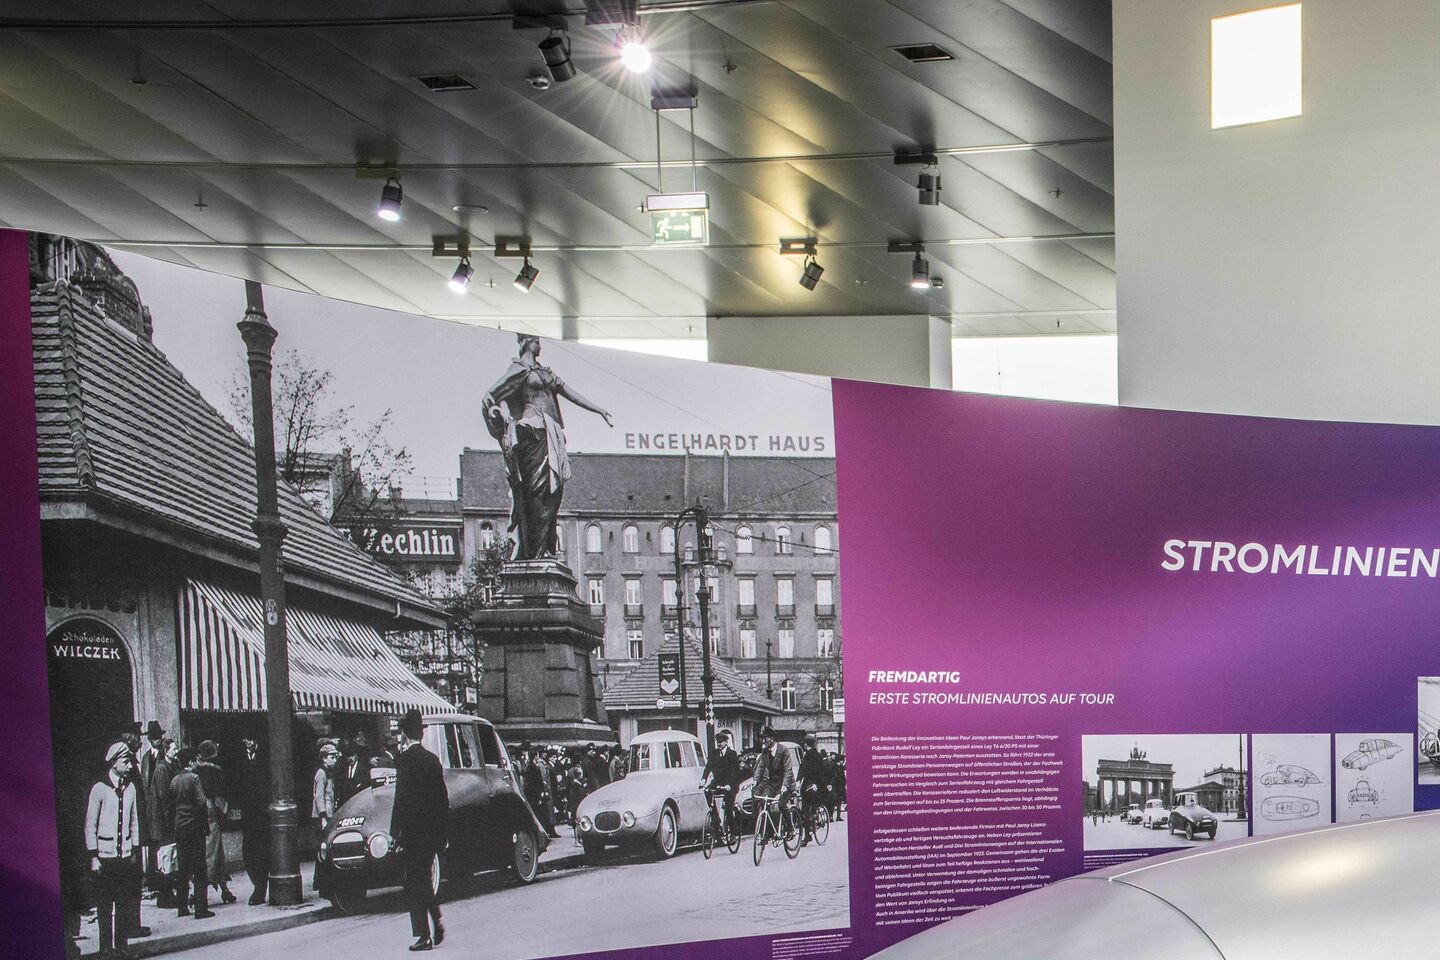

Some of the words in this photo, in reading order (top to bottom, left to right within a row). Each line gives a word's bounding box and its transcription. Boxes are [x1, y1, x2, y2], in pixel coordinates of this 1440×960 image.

[625, 433, 758, 450] ENGELHARDT
[769, 435, 825, 451] HAUS
[54, 645, 120, 660] WILCZEK
[868, 670, 960, 683] FREMDARTIG
[869, 692, 909, 704] ERSTE
[912, 692, 1047, 705] STROMLINIENAUTOS
[1049, 693, 1076, 705] AUF
[1080, 693, 1114, 705] TOUR
